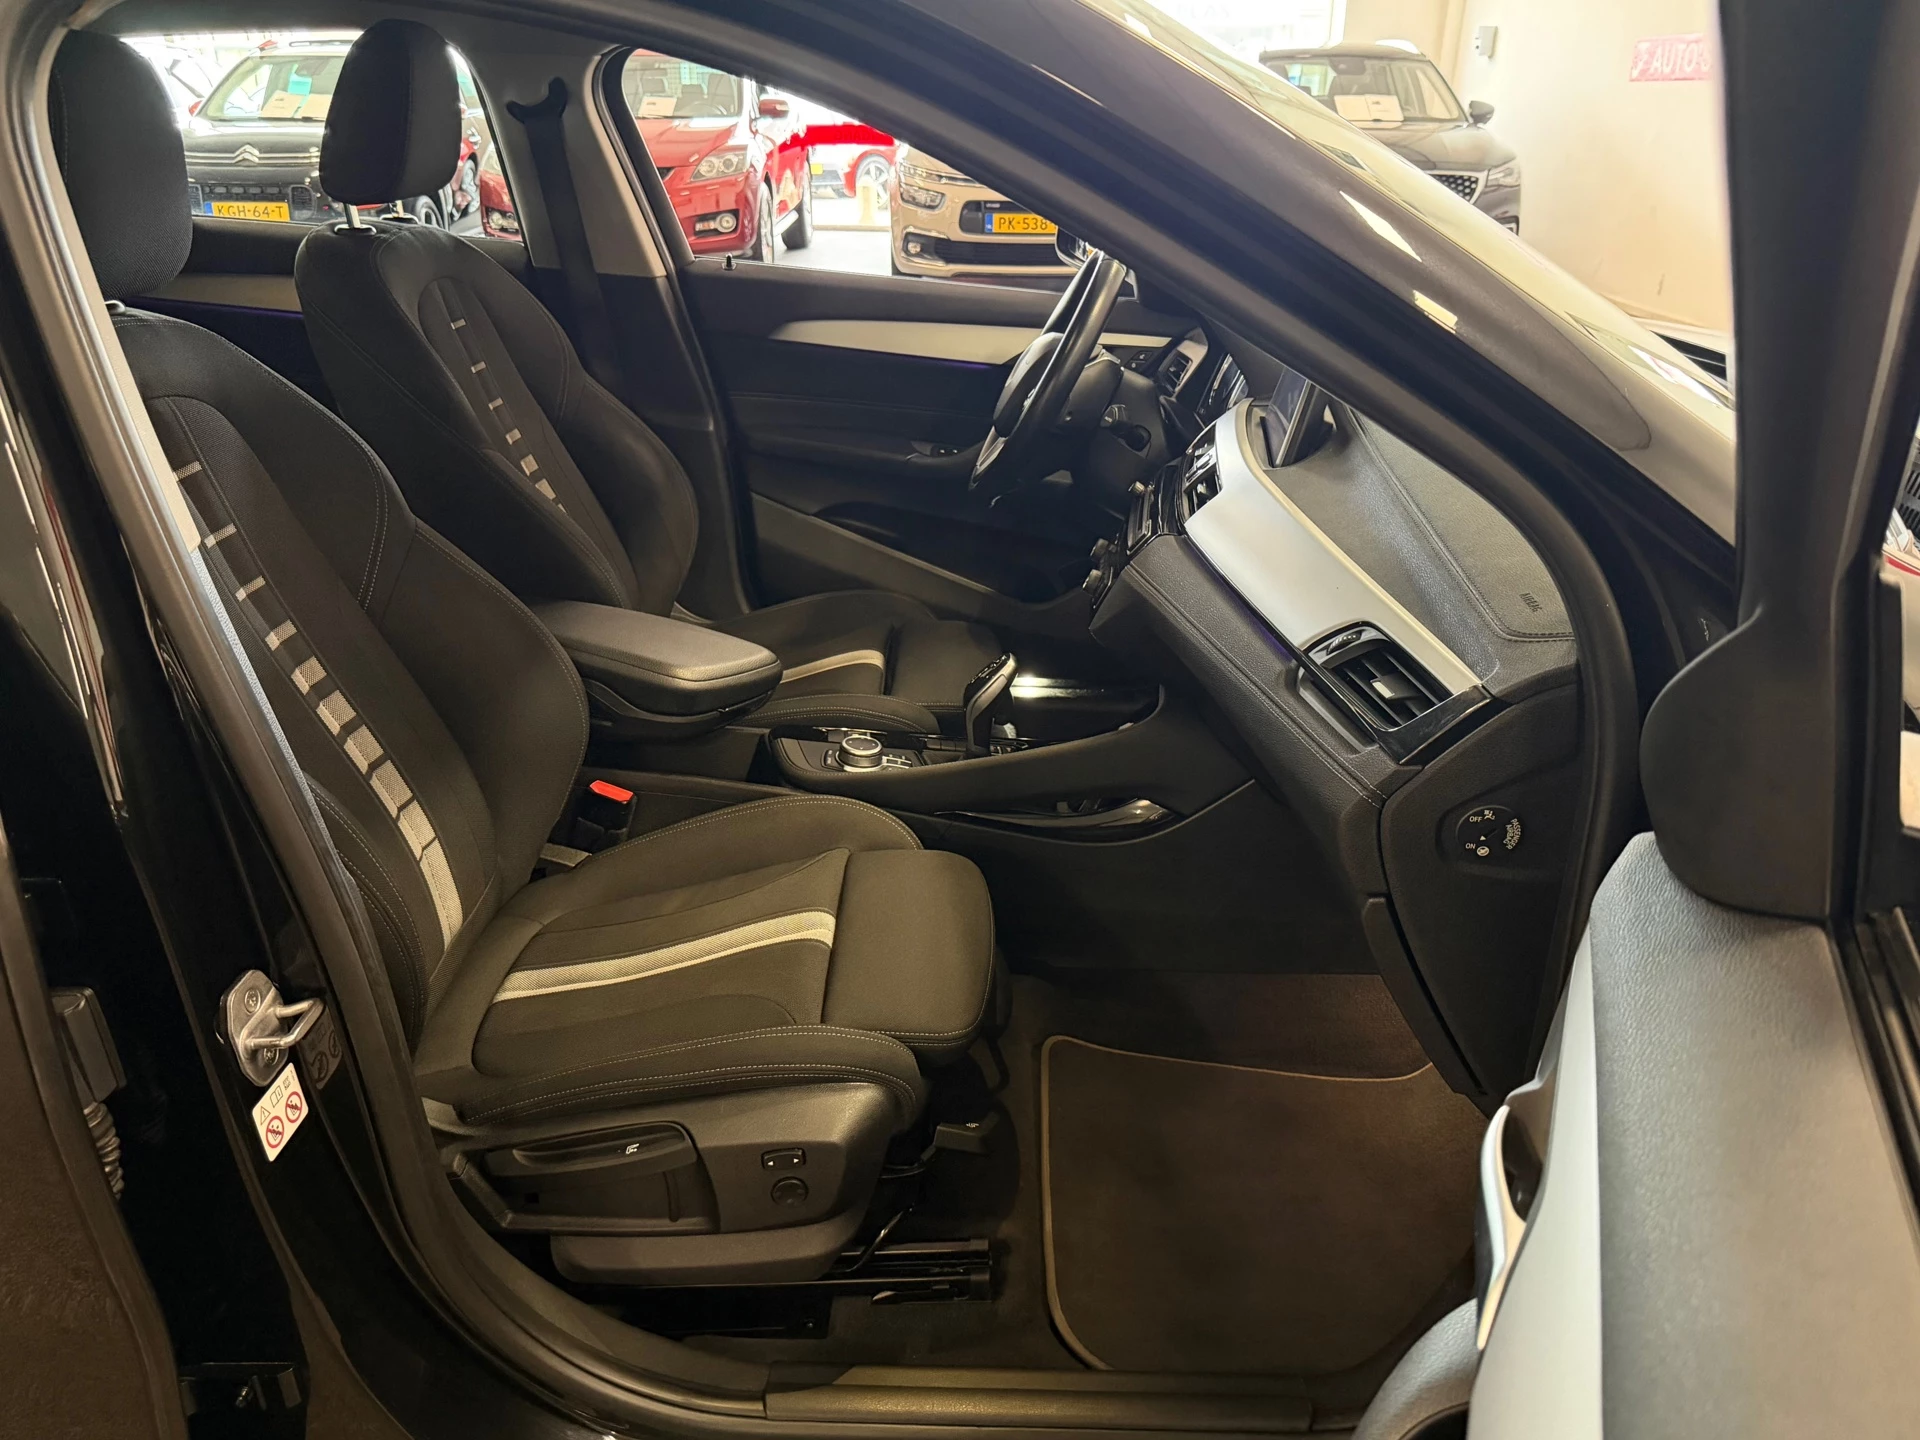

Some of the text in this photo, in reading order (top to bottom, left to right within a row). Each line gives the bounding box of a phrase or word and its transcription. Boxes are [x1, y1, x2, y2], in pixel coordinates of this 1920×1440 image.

[217, 205, 283, 218] KGH-64-T
[998, 216, 1052, 230] PK-538
[1506, 818, 1521, 850] PASSENGER
